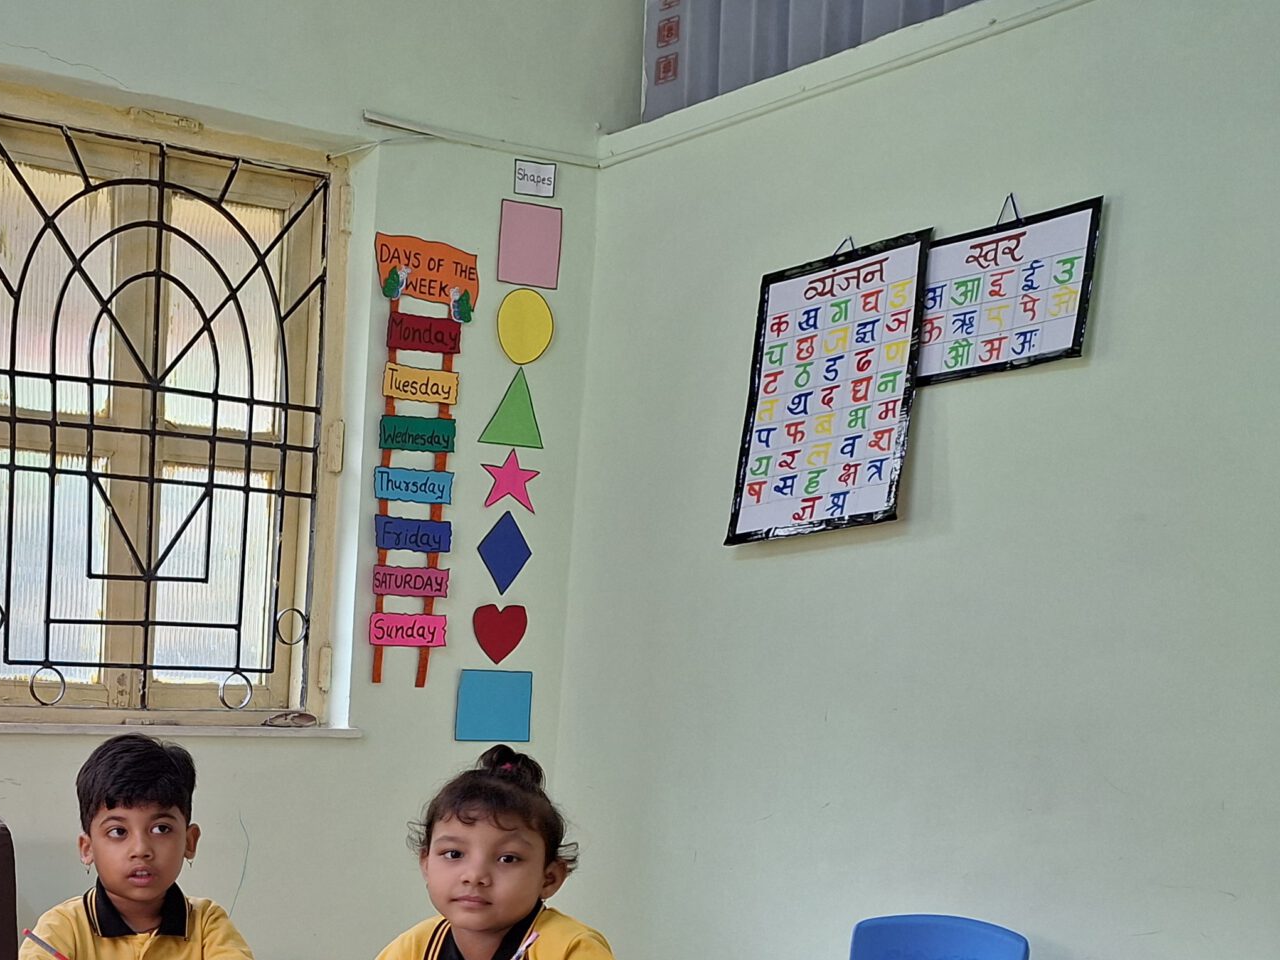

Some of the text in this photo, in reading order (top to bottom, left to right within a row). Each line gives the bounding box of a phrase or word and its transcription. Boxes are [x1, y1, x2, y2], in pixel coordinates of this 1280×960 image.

[517, 167, 552, 187] Shapes
[380, 243, 477, 281] DAYS OF THE
[965, 231, 1027, 269] स्वर
[405, 277, 450, 297] WEEK
[804, 256, 890, 300] व्यंजन
[389, 317, 458, 351] Monday
[388, 367, 452, 400] Tuesday
[382, 424, 450, 449] Wednesday
[377, 470, 445, 500] Thursday
[382, 521, 442, 551] Friday
[374, 571, 444, 593] SATURDAY
[374, 618, 437, 644] Sunday
